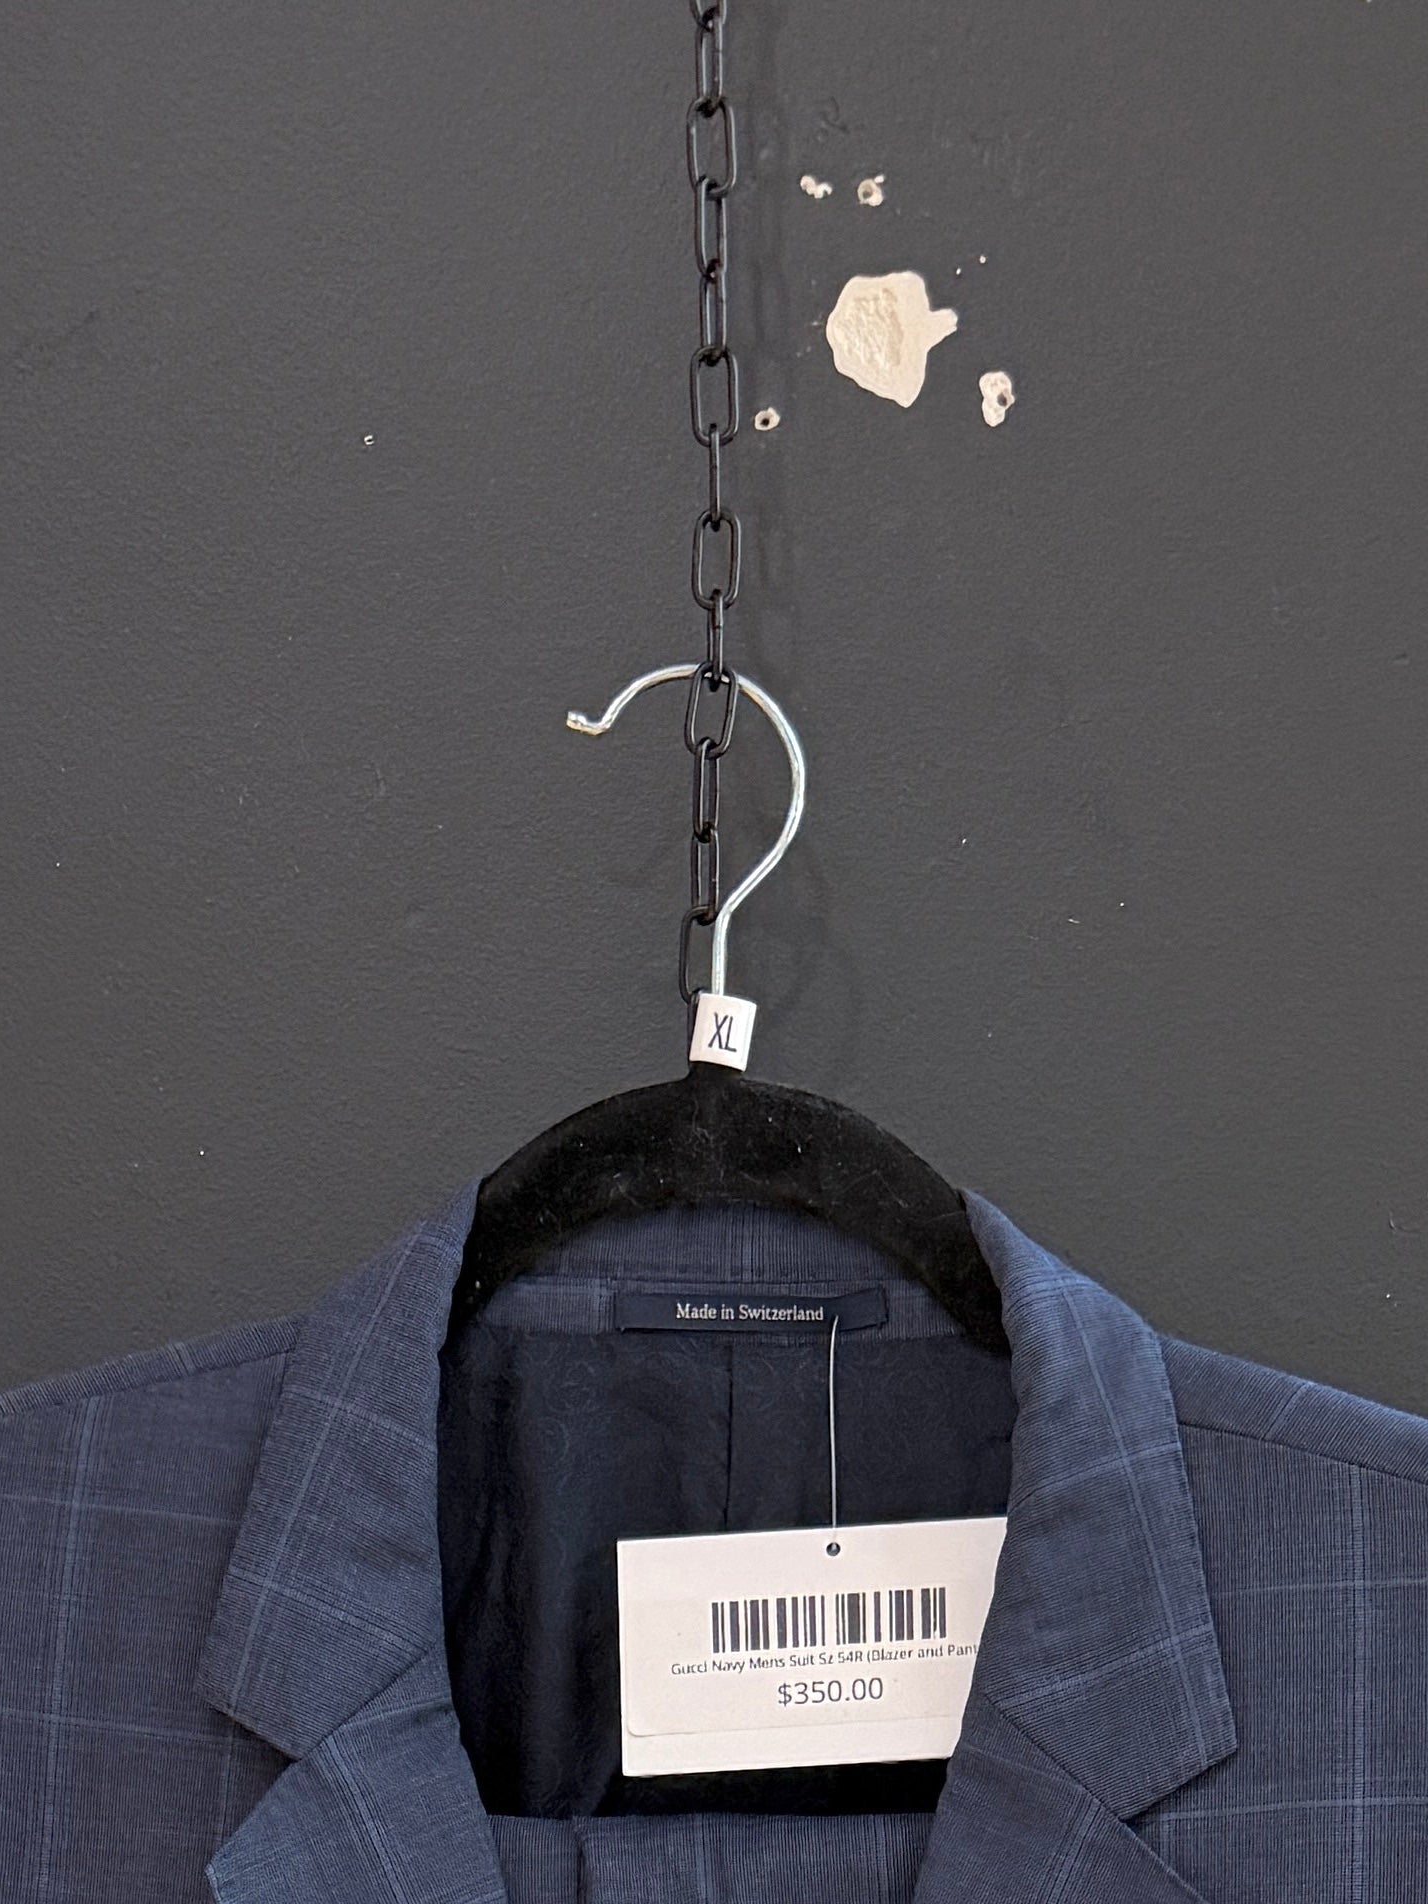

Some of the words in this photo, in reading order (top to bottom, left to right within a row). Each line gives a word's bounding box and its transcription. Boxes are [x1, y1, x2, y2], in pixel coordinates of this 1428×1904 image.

[708, 1012, 737, 1053] XL
[676, 1302, 717, 1320] Made
[721, 1303, 735, 1320] in
[738, 1304, 824, 1321] Switzerland
[671, 1660, 708, 1675] Gucci
[712, 1659, 745, 1675] Navy
[749, 1656, 786, 1670] Mens
[789, 1653, 815, 1667] Suit
[818, 1651, 834, 1665] Sz
[838, 1650, 863, 1664] 54R
[867, 1648, 913, 1663] (Blazer
[917, 1645, 944, 1659] and
[778, 1677, 884, 1707] $350.00
